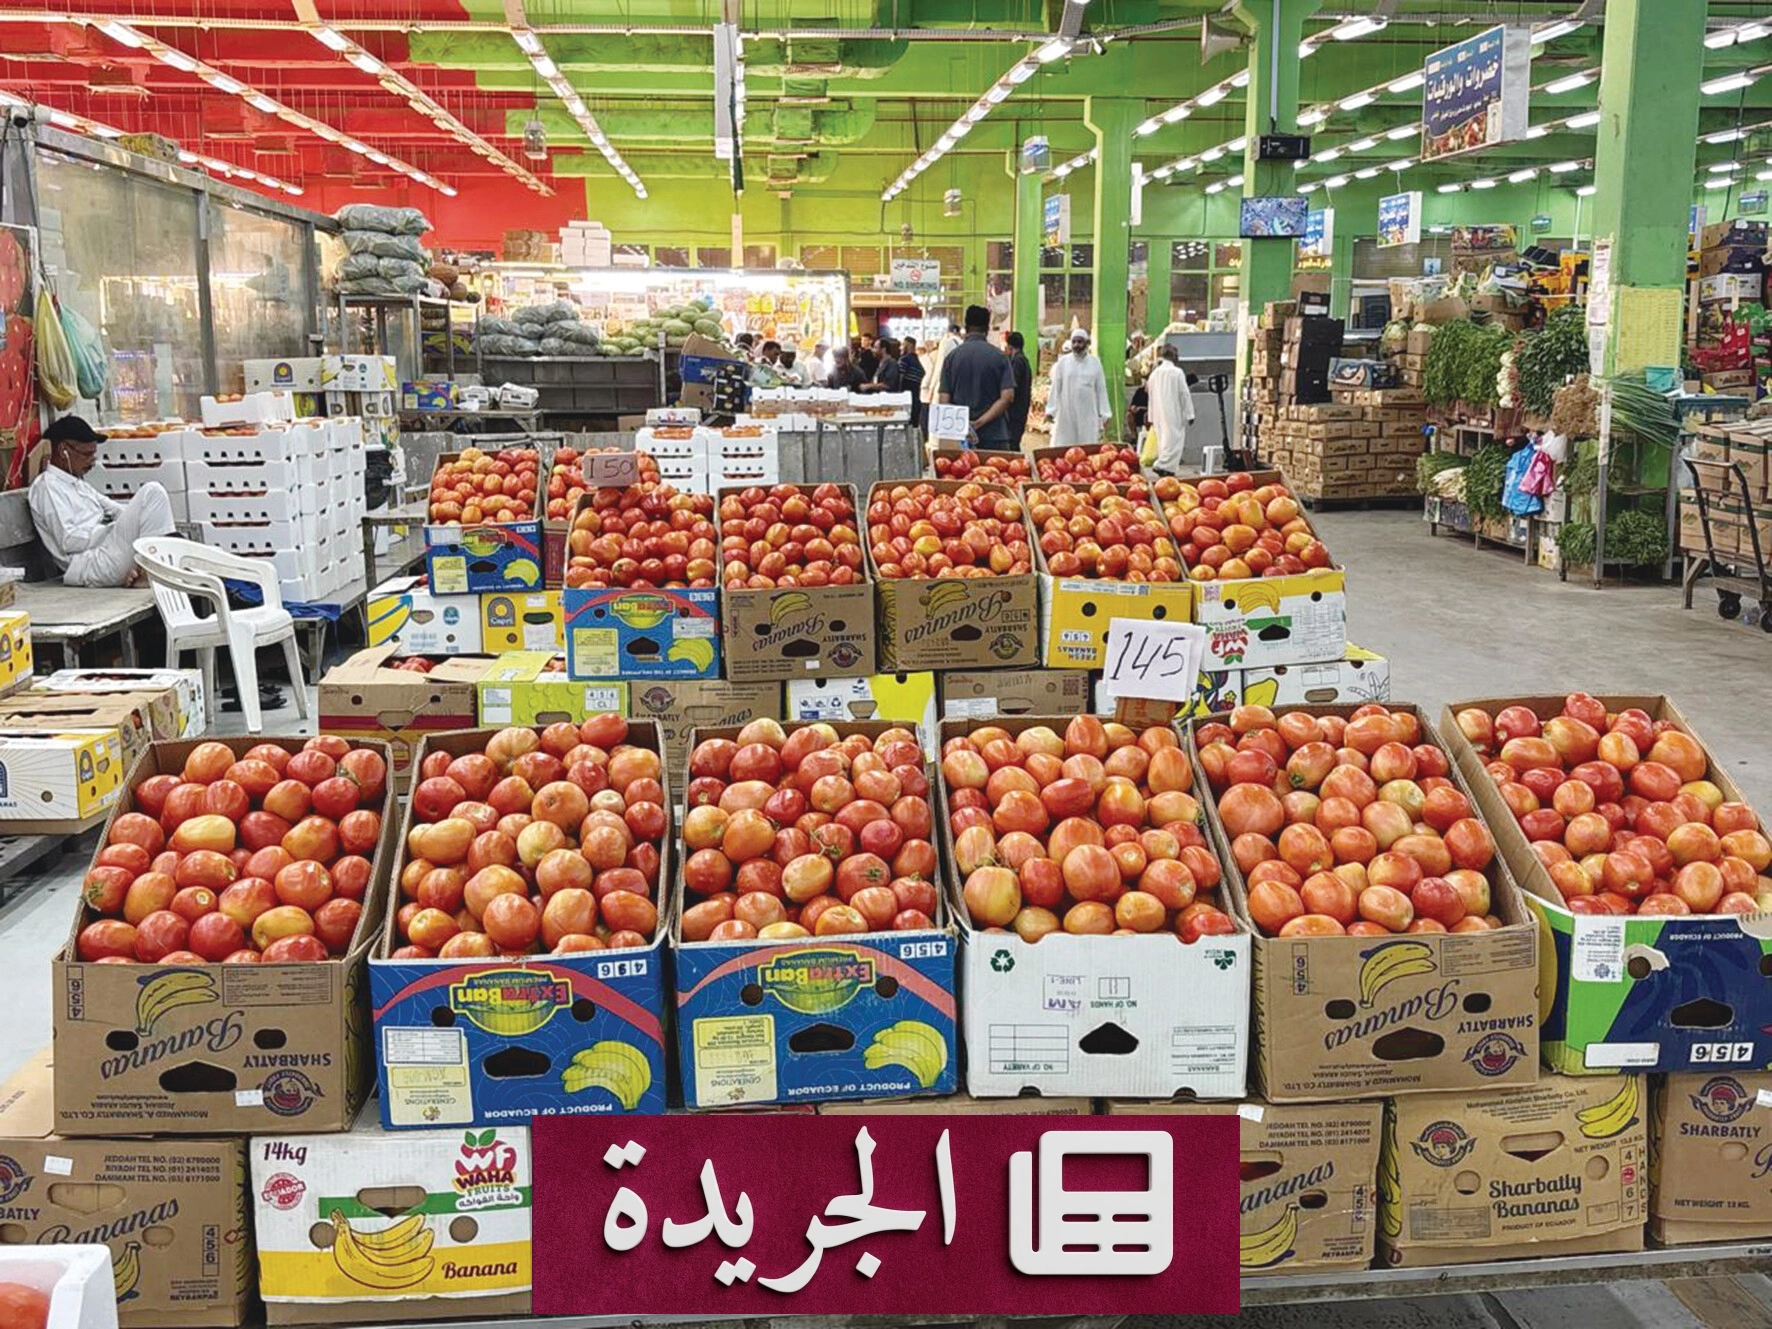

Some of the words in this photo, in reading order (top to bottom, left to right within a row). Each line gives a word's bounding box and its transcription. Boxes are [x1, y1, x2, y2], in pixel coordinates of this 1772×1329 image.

[934, 406, 966, 432] 155
[904, 590, 1003, 644] Bananas
[752, 612, 825, 652] Bananas
[822, 633, 866, 642] SHARBATLY
[1057, 646, 1097, 654] BANANAS
[1109, 631, 1186, 680] 145
[1669, 933, 1702, 941] ECUADOR
[1703, 933, 1712, 941] OF
[1713, 932, 1743, 940] PRODUCT
[764, 963, 871, 984] ExtraBan
[457, 985, 568, 1005] ExtraBan
[1323, 979, 1460, 1051] Bananas
[1456, 1014, 1534, 1034] SHARBATLY
[99, 1009, 245, 1081] Bananas
[242, 1053, 332, 1068] SHARBATLY
[1003, 1063, 1030, 1071] VARIETY
[711, 1076, 761, 1086] GENERATIONS
[1317, 1079, 1362, 1088] SHARBATLY
[1373, 1074, 1421, 1085] MOHAMMED
[787, 1085, 839, 1096] ECUADOR
[841, 1083, 857, 1092] OF
[859, 1082, 911, 1091] PRODUCT
[484, 1108, 538, 1119] ECUADOR
[541, 1107, 556, 1116] OF
[558, 1103, 613, 1114] PRODUCT
[1680, 1122, 1762, 1138] SHARBATLY
[104, 1155, 136, 1163] JEDDAH
[263, 1141, 307, 1166] 14kg
[1625, 1151, 1632, 1160] 4
[152, 1165, 167, 1173] NO.
[95, 1174, 136, 1182] DAMMAM
[137, 1174, 151, 1182] TEL
[152, 1174, 167, 1182] NO.
[455, 1171, 514, 1190] WAHA
[467, 1184, 510, 1195] FRUITS
[1489, 1174, 1582, 1198] Sharbatly
[1626, 1187, 1634, 1198] 6
[1492, 1198, 1579, 1219] Bananas
[1627, 1206, 1634, 1216] 7
[442, 1261, 518, 1279] Banana
